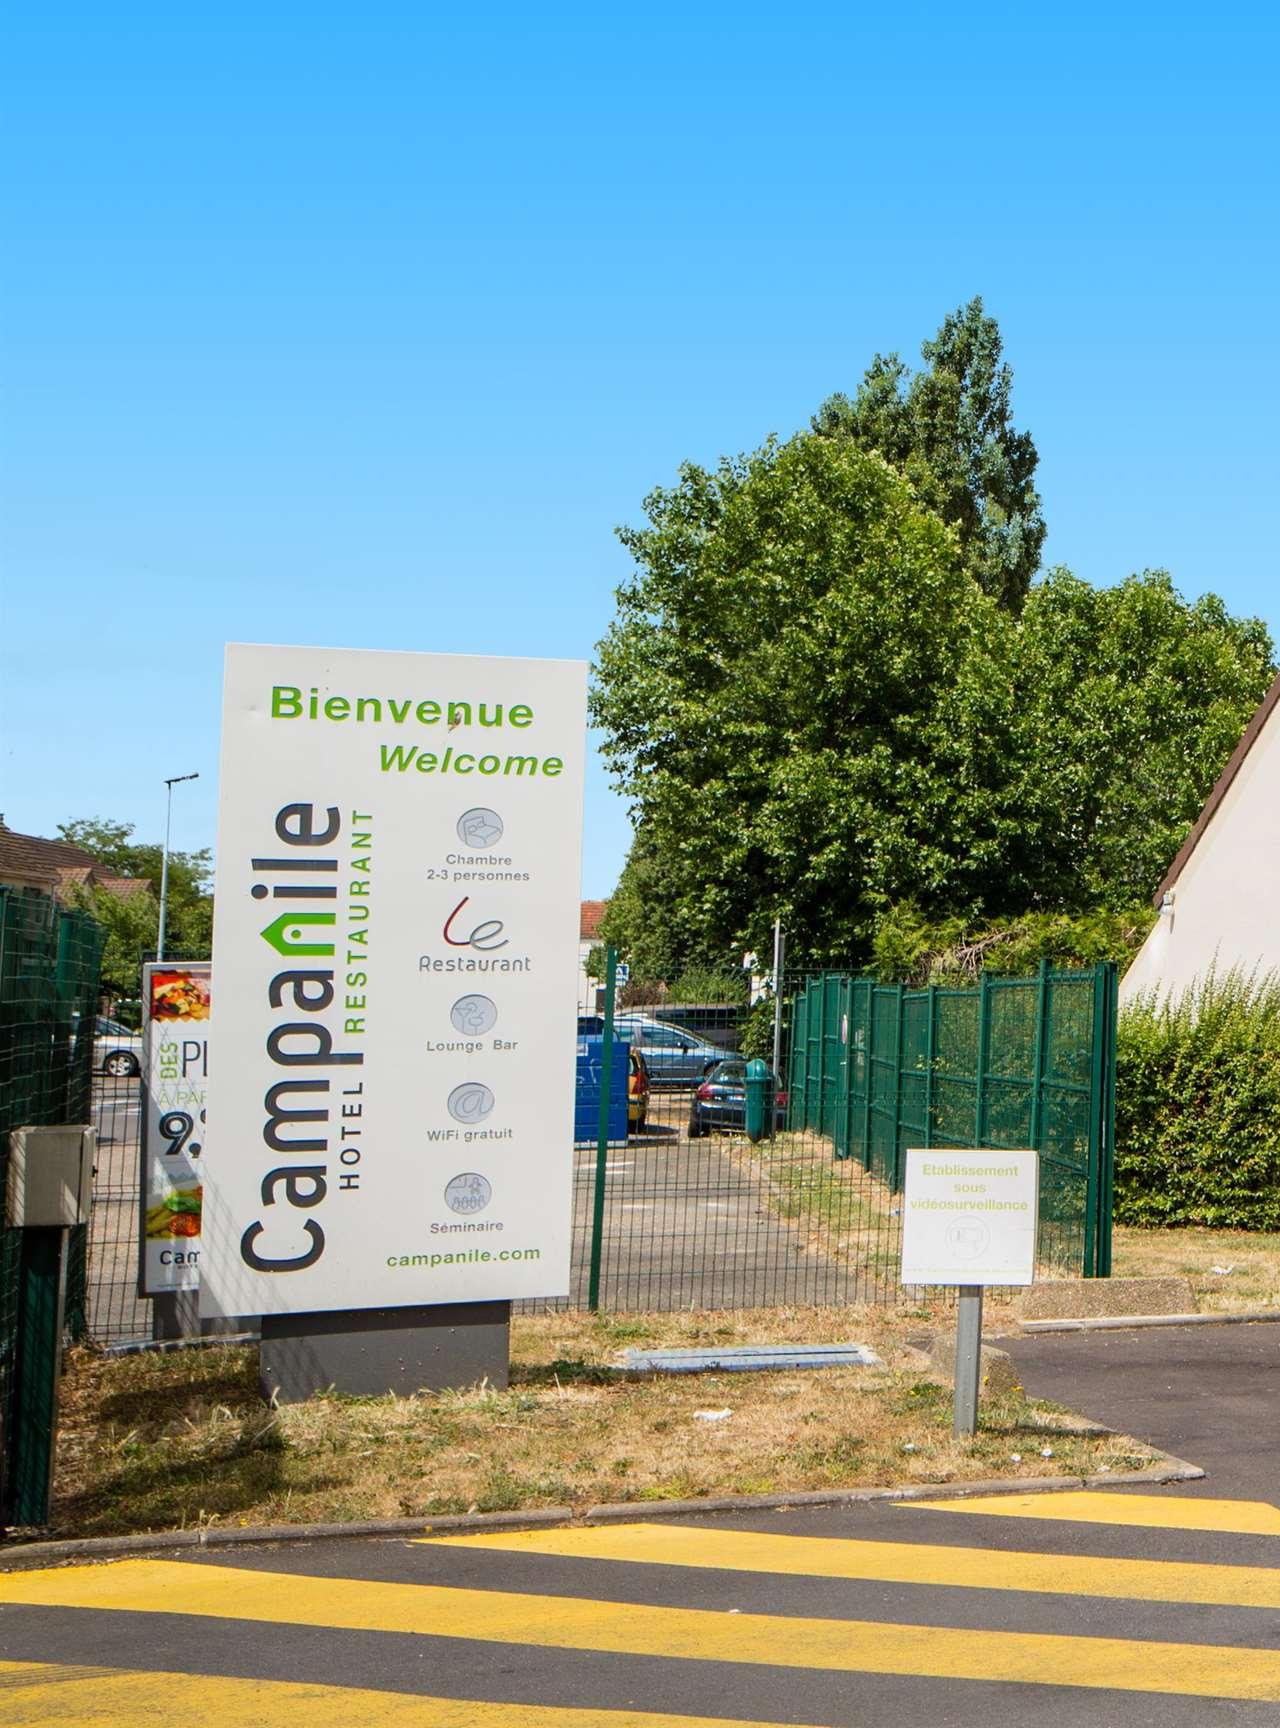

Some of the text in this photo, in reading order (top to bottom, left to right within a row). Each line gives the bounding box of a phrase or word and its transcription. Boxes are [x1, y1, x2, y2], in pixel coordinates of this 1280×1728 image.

[271, 685, 534, 728] Bienvenue
[380, 745, 563, 777] Welcome
[445, 853, 512, 866] Chambre
[426, 868, 530, 882] 2-3 personnes
[418, 955, 531, 972] Restaurant
[339, 809, 373, 1191] HOTEL RESTAURANT
[240, 802, 364, 1274] Campanile
[426, 1039, 519, 1054] Lounge Bar
[159, 1041, 179, 1079] DES
[427, 1128, 513, 1143] WiFi gratuit
[921, 1164, 1019, 1177] Etablissement
[953, 1184, 987, 1193] sous
[429, 1220, 504, 1235] Séminaire
[386, 1248, 541, 1269] campanile.com
